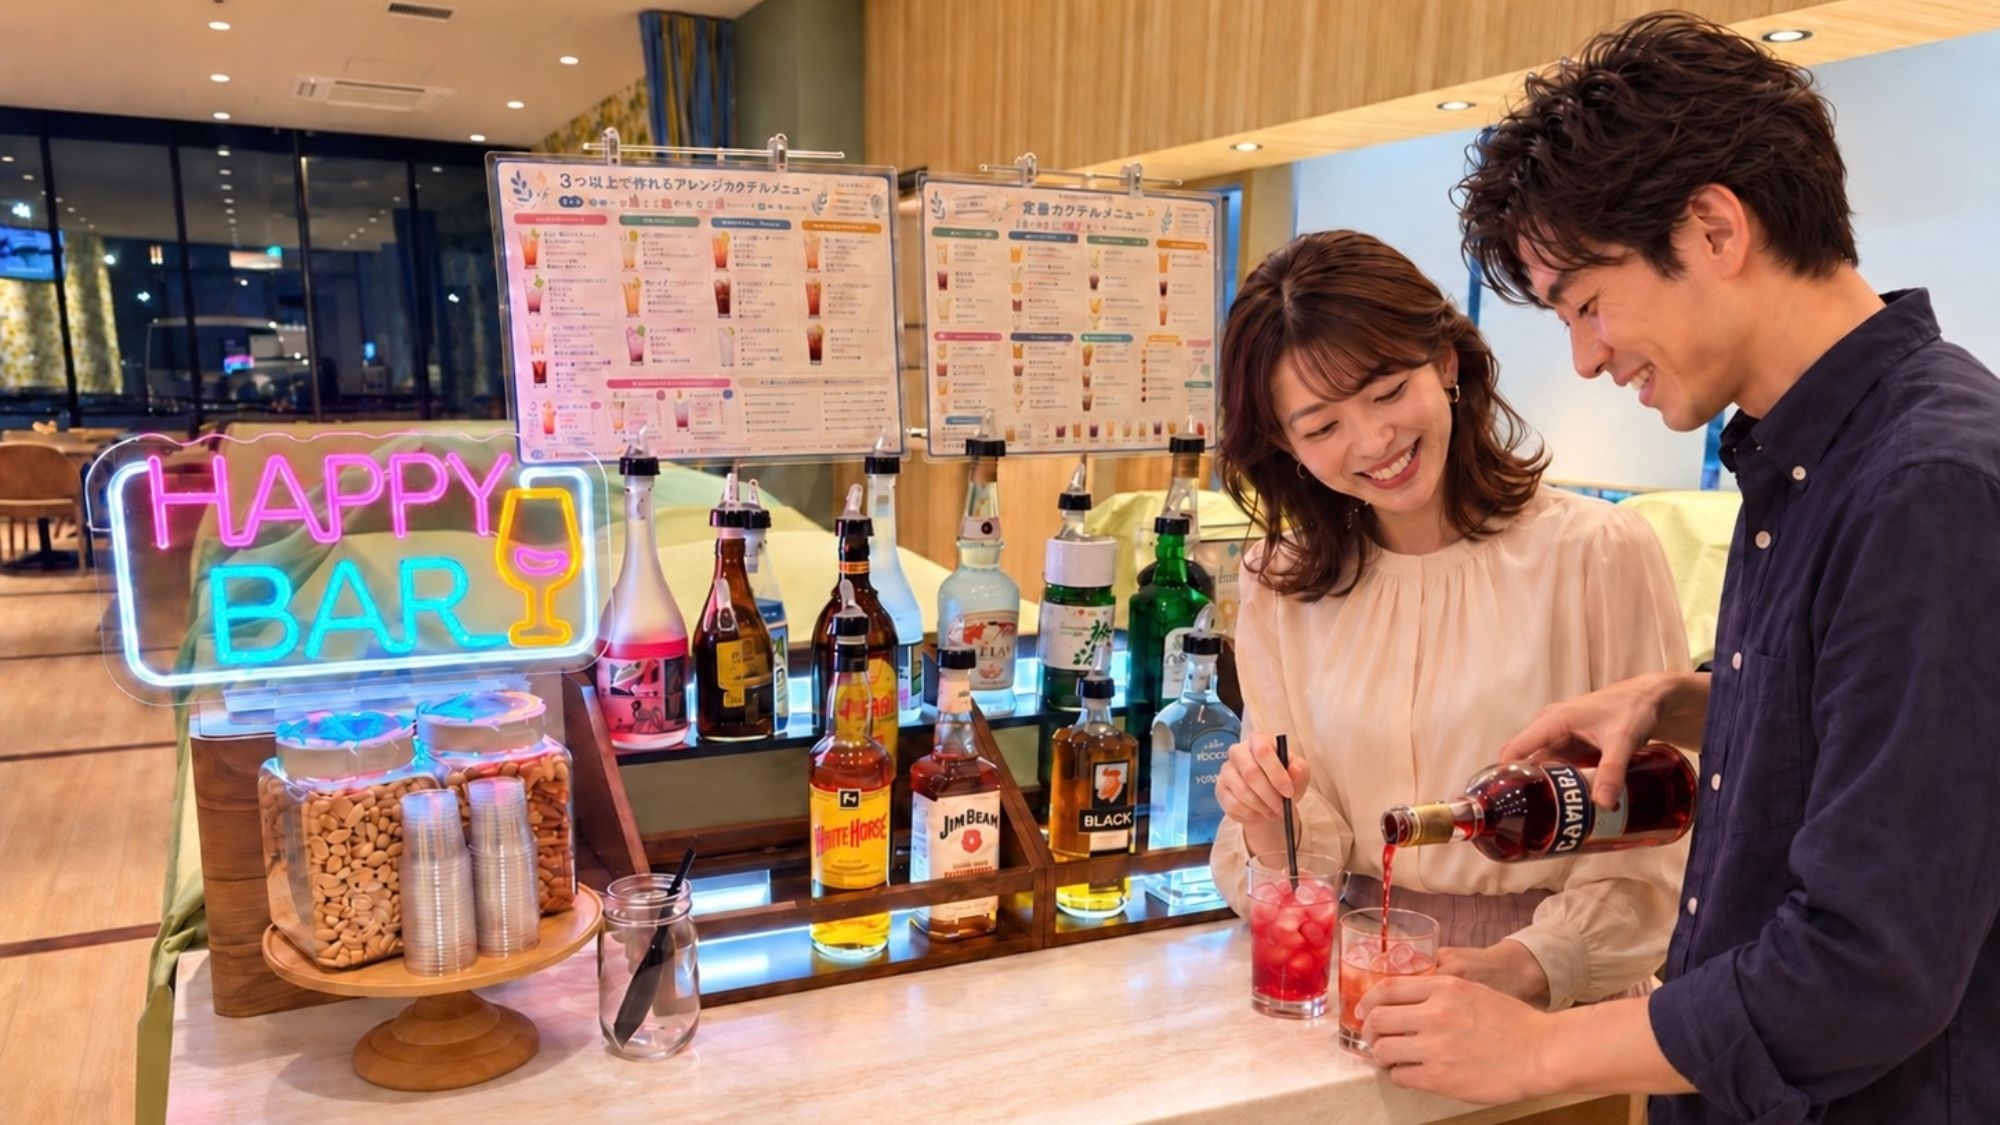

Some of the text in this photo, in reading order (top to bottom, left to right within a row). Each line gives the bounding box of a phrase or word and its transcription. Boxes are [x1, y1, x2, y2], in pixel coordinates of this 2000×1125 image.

[148, 454, 511, 548] HAPPY
[210, 557, 508, 664] BAR
[814, 812, 888, 857] WHITE HORSE
[939, 809, 999, 840] JIM BEAM
[1084, 811, 1132, 828] BLACK
